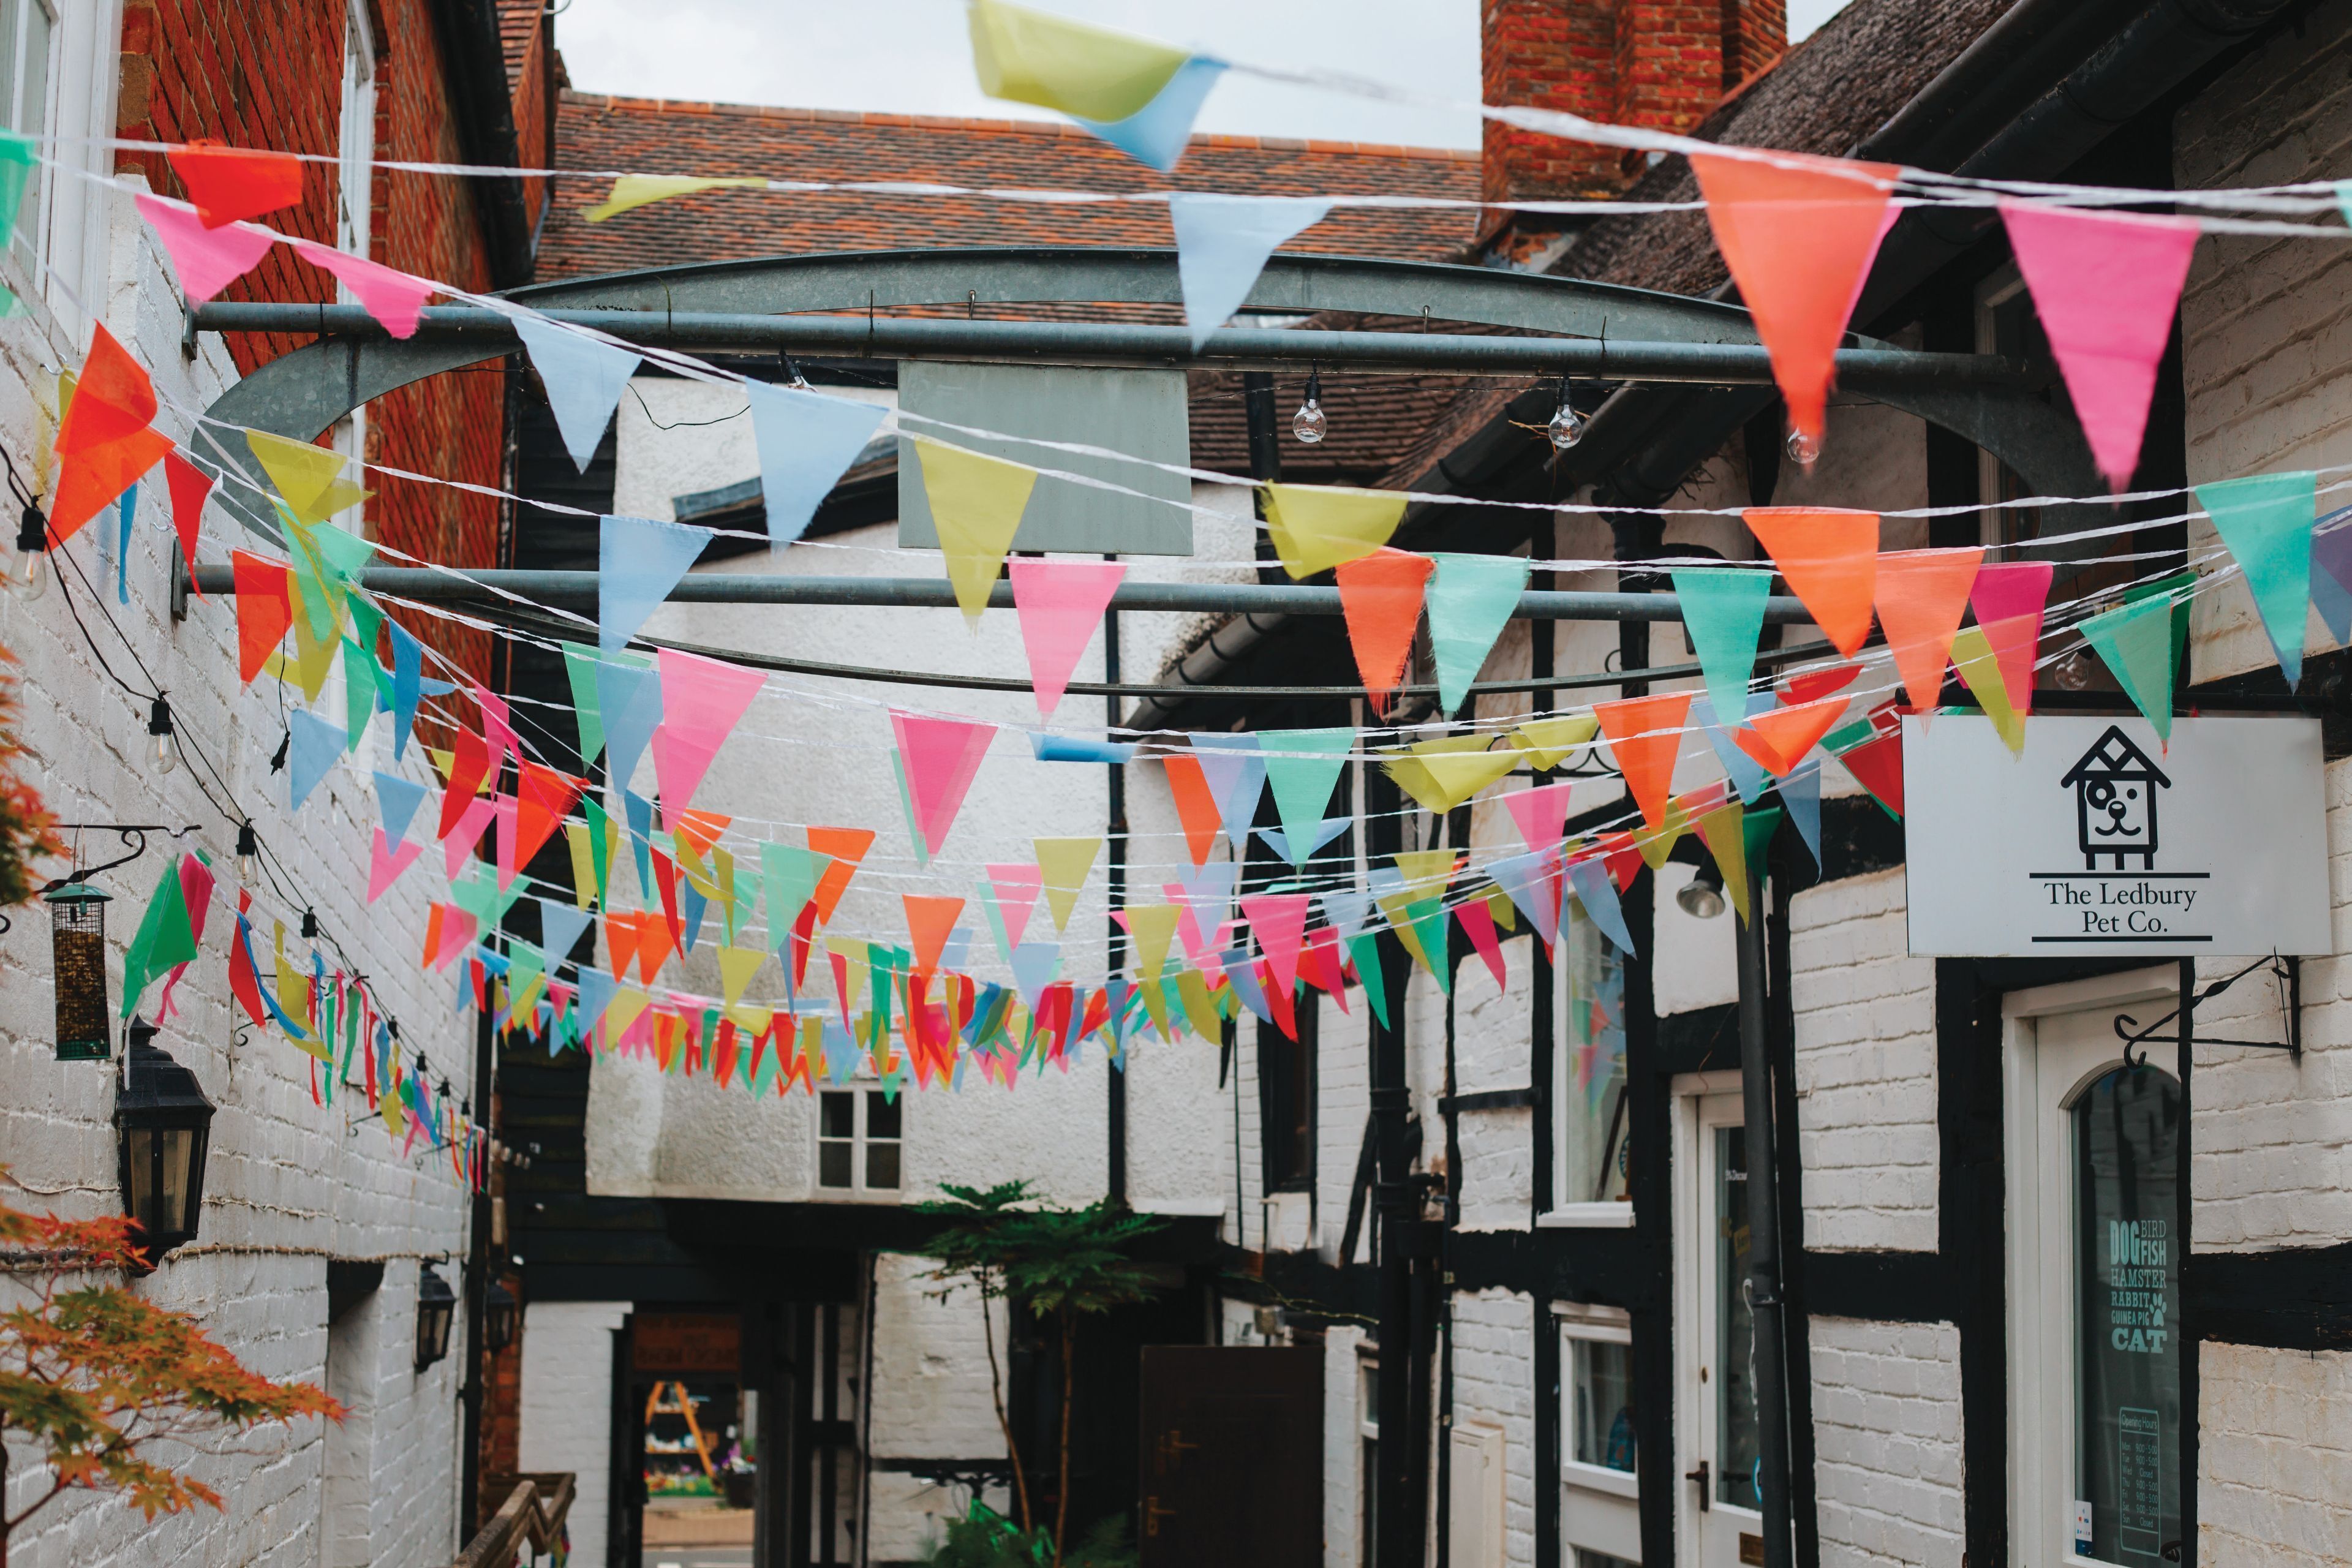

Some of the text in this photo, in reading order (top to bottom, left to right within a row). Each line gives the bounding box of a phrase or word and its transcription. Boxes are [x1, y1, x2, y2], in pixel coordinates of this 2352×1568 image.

[2043, 882, 2198, 912] The Ledbury
[2081, 910, 2168, 932] Pet Co.
[2141, 1220, 2166, 1238] BIRD
[2110, 1220, 2140, 1265] DOG
[2141, 1240, 2167, 1266] FISH
[2111, 1268, 2167, 1289] HAMSTER
[2111, 1291, 2150, 1308] RABBIT
[2111, 1310, 2150, 1326] GUINEA PIG
[2112, 1327, 2168, 1354] CAT
[2121, 1414, 2157, 1431] Opening Hours
[2122, 1441, 2131, 1451] Mon
[2122, 1465, 2153, 1479] Wed Closed
[2139, 1517, 2154, 1528] Closed
